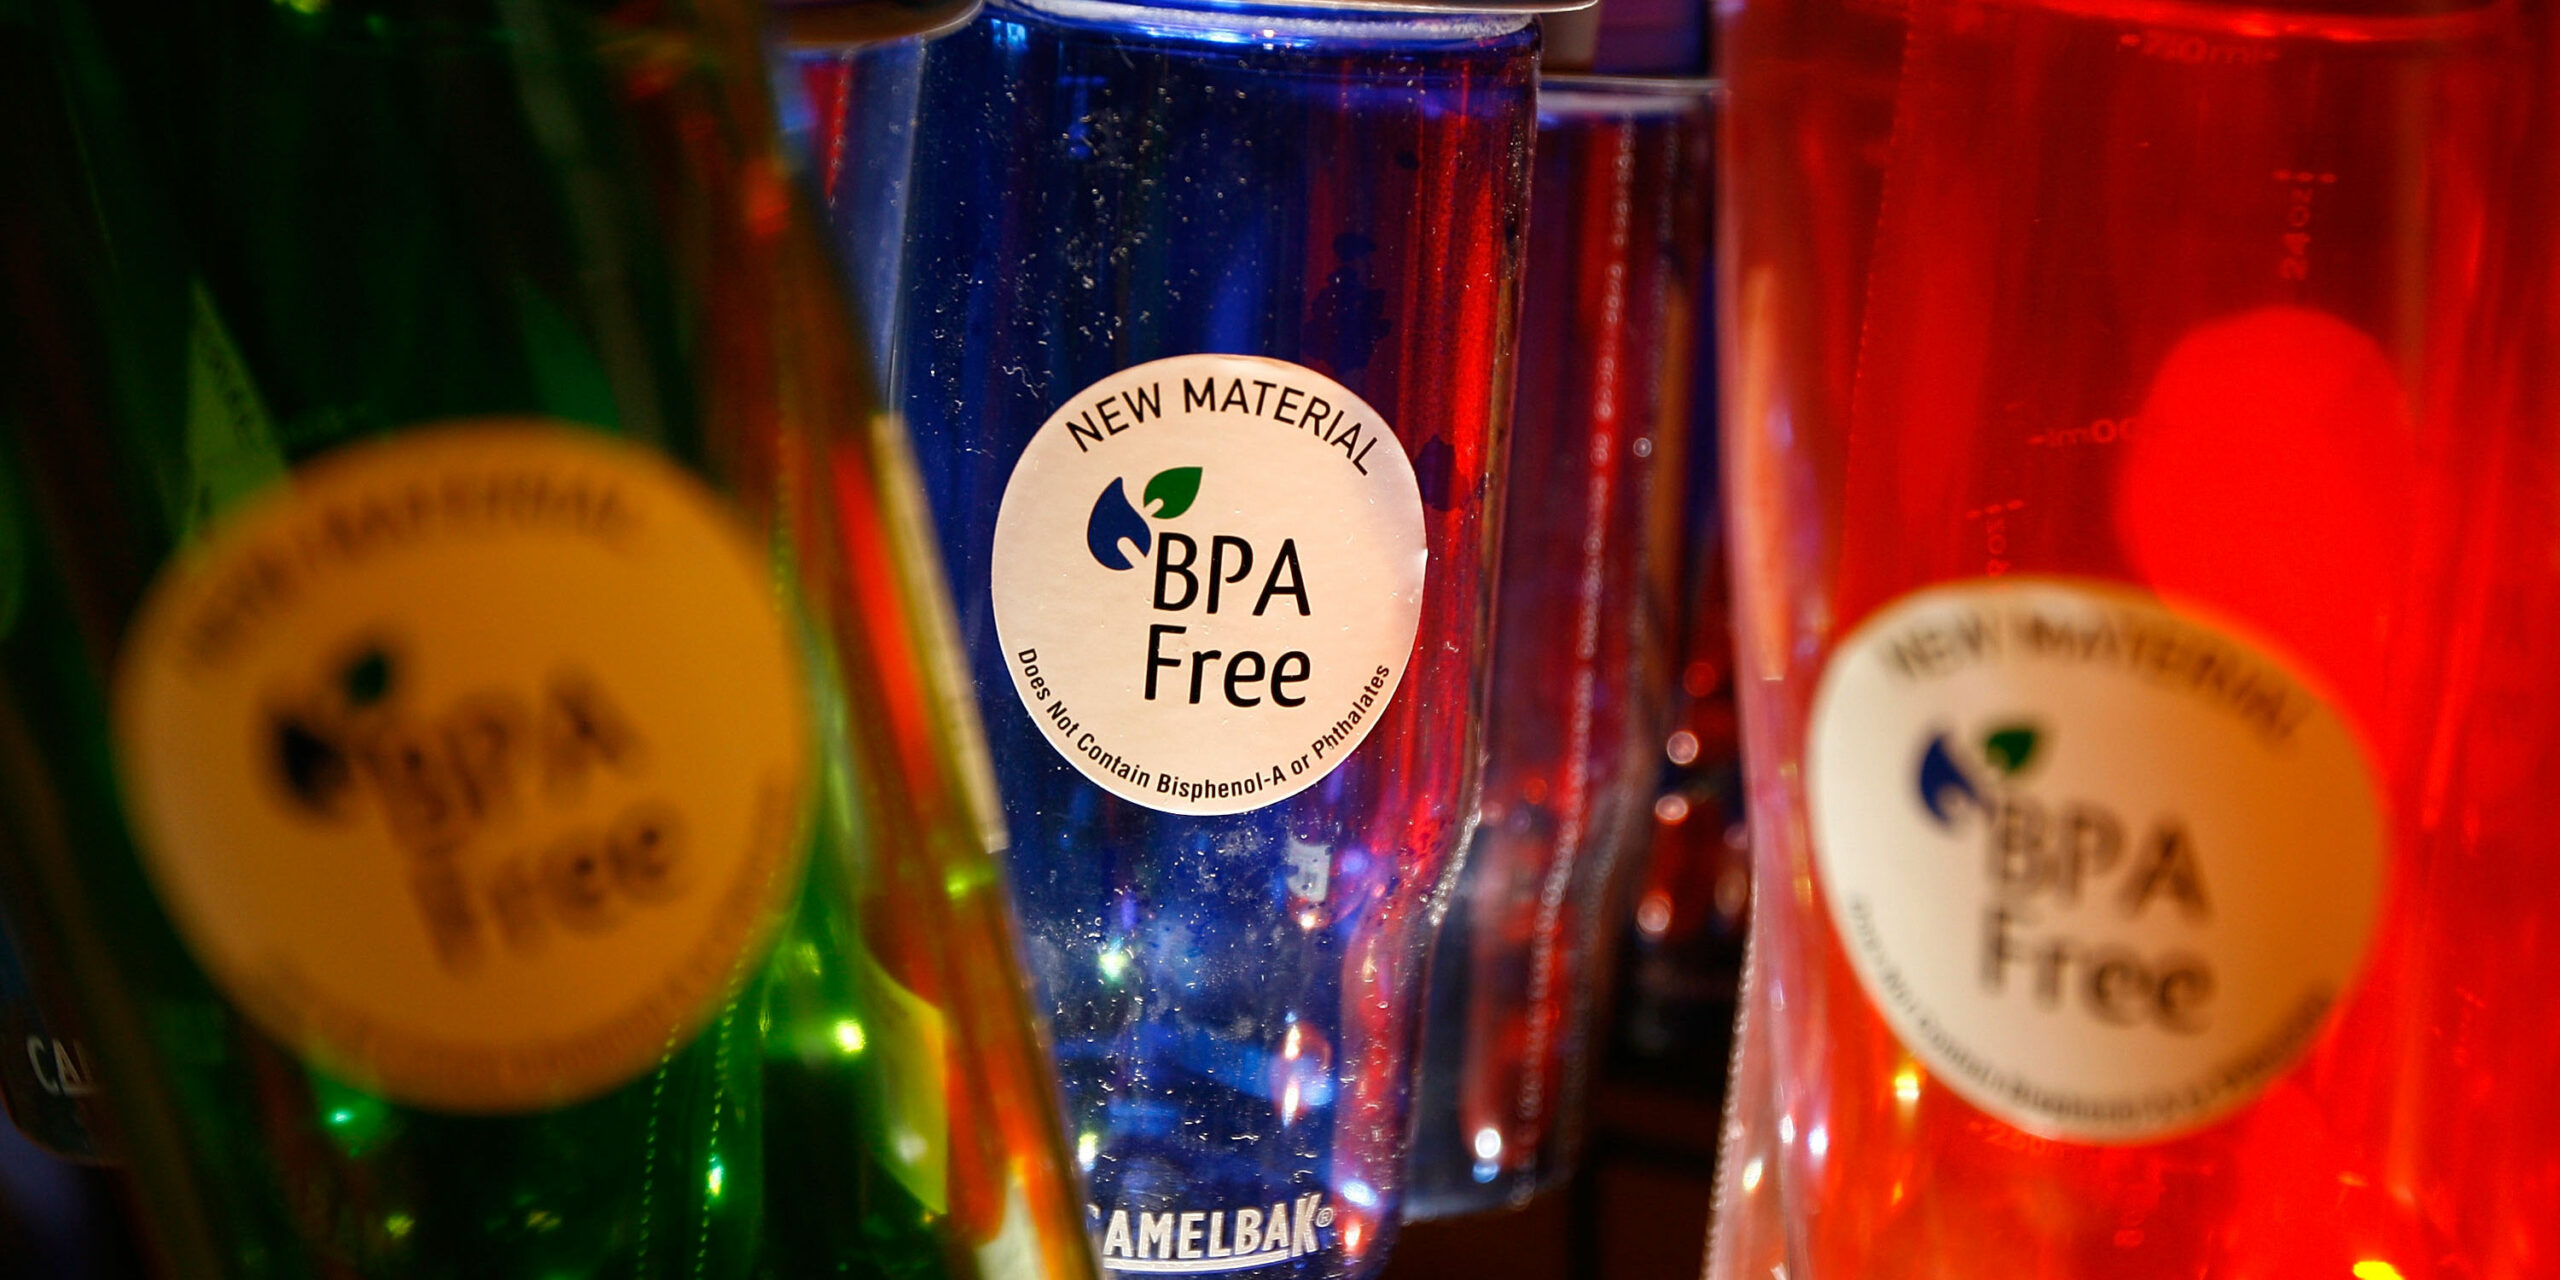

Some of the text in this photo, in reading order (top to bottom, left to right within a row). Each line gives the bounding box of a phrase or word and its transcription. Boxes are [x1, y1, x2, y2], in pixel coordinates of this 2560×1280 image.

[1065, 378, 1378, 476] NEW MATERIAL
[1153, 532, 1311, 616] BPA
[1144, 624, 1311, 708] Free
[1018, 648, 1390, 802] Does Not Contain Bisphenol-A or Phthalates
[1986, 800, 2214, 928] BPA
[1979, 907, 2216, 1037] Free
[1088, 1193, 1333, 1259] AMELBAK®
